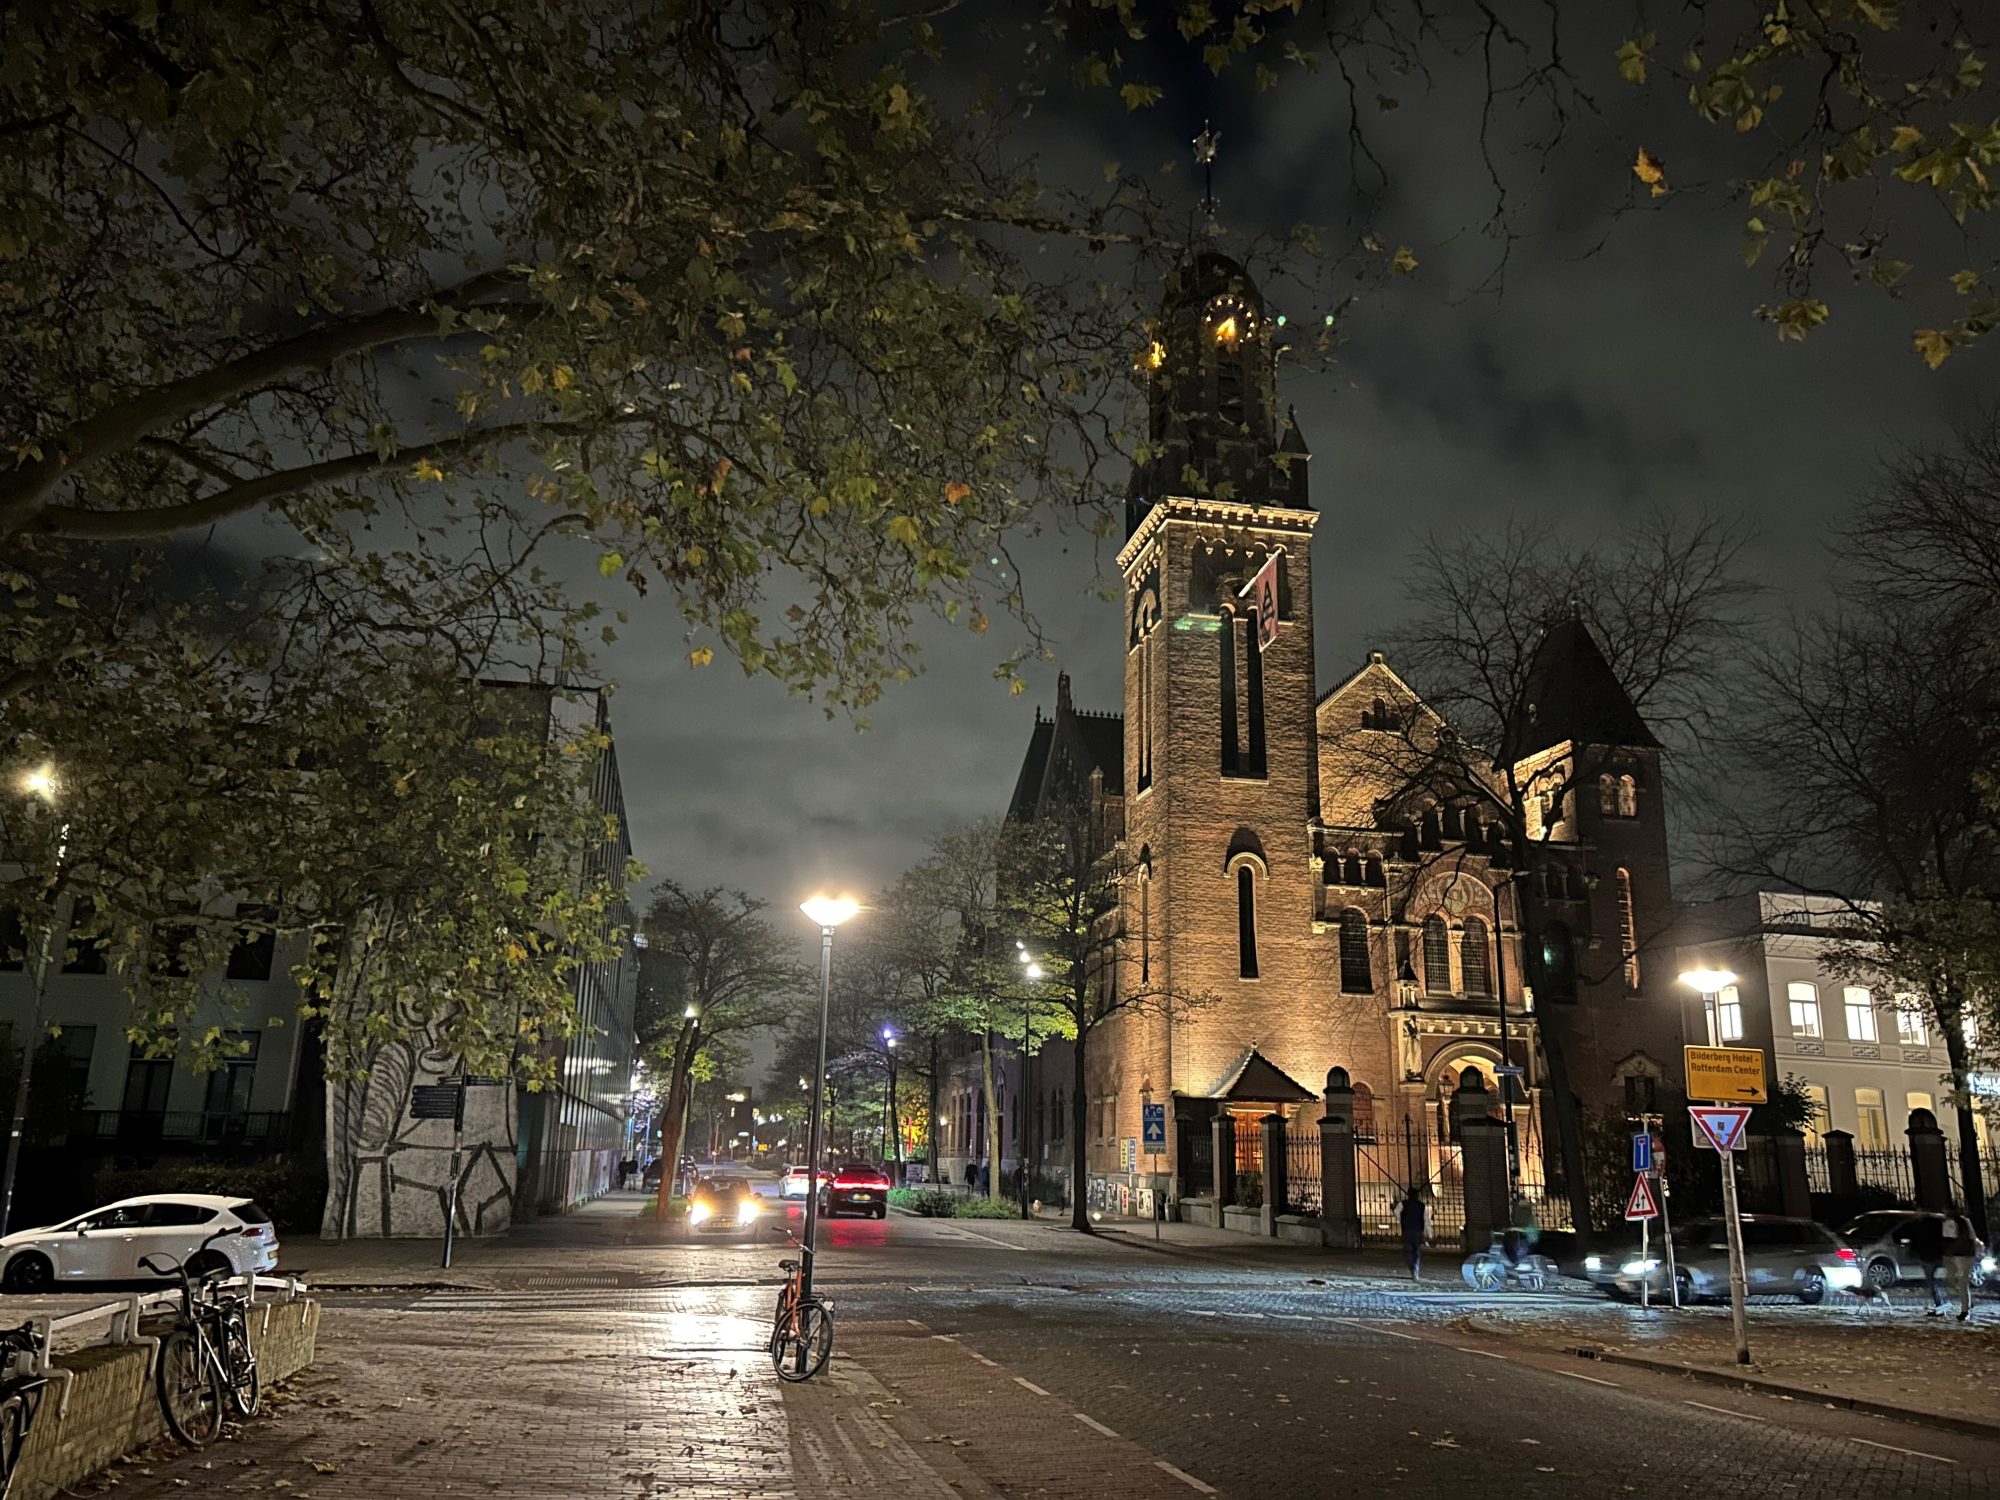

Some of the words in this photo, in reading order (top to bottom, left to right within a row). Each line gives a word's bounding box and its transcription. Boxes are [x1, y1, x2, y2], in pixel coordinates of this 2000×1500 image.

[1690, 1051, 1731, 1063] Bilderberg
[1732, 1053, 1753, 1063] Hotel
[1691, 1063, 1733, 1074] Rotterdam
[1734, 1065, 1760, 1075] Center
